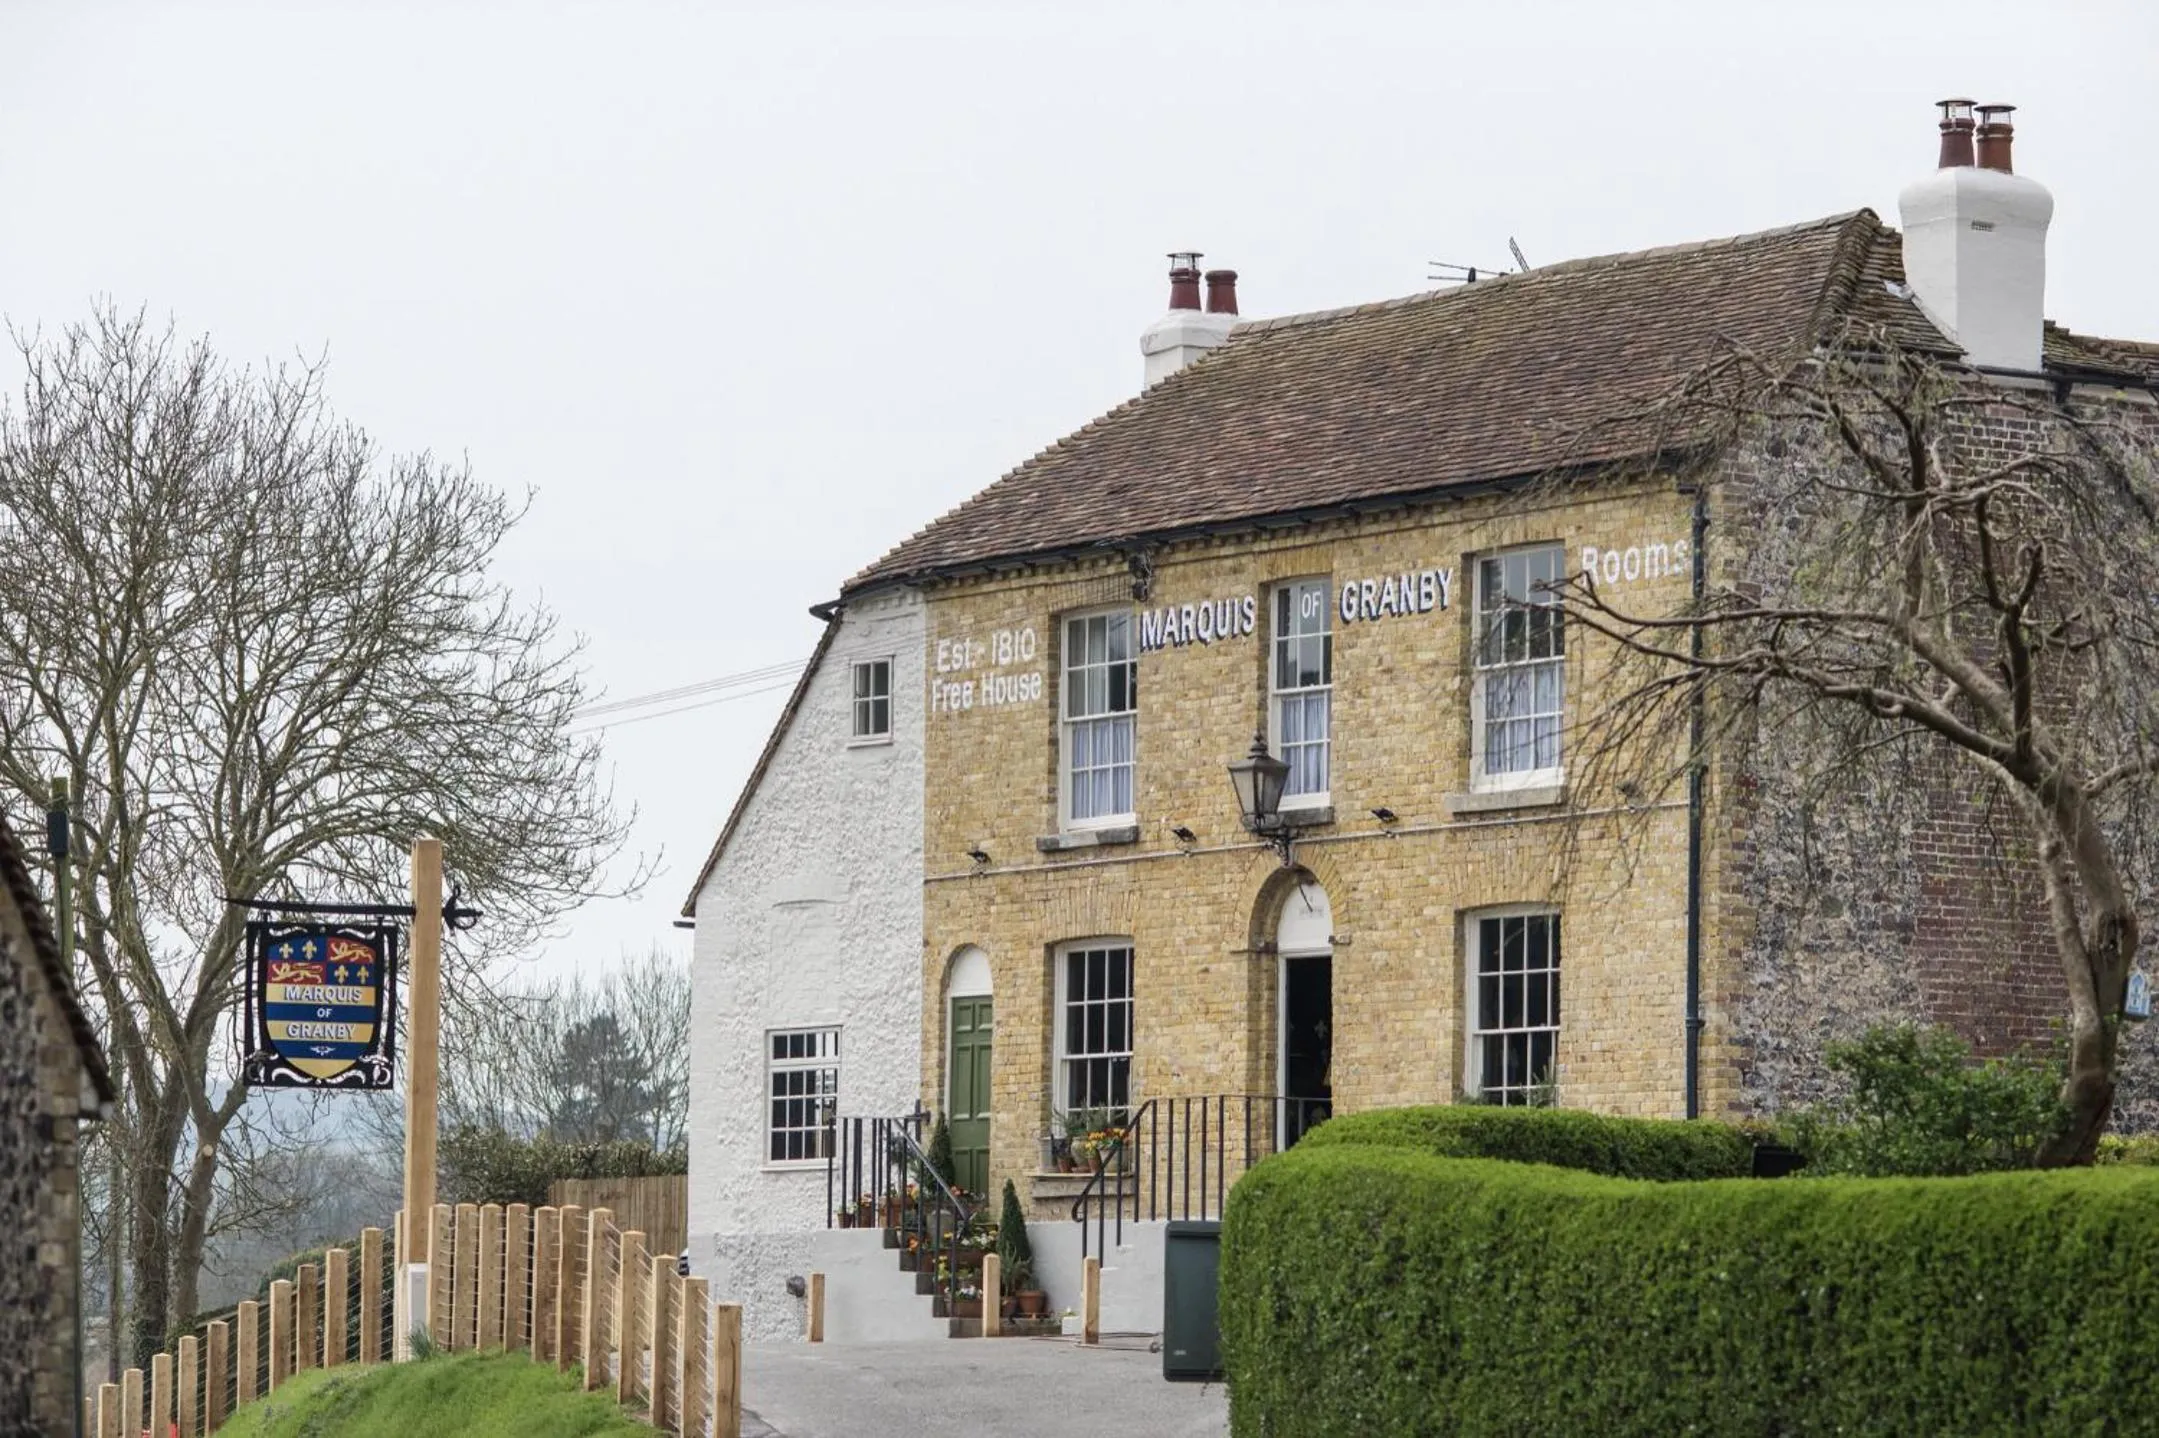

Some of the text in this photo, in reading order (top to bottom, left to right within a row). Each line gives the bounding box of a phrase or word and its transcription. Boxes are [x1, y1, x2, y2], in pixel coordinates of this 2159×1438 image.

[1581, 539, 1688, 587] Rooms
[1140, 567, 1453, 652] MARQUIS OF GRANBY
[992, 627, 1035, 665] 1810
[932, 672, 1041, 712] Free House
[285, 985, 362, 1003] MARQUIS
[317, 1008, 332, 1018] OF
[287, 1022, 356, 1040] GRANBY
